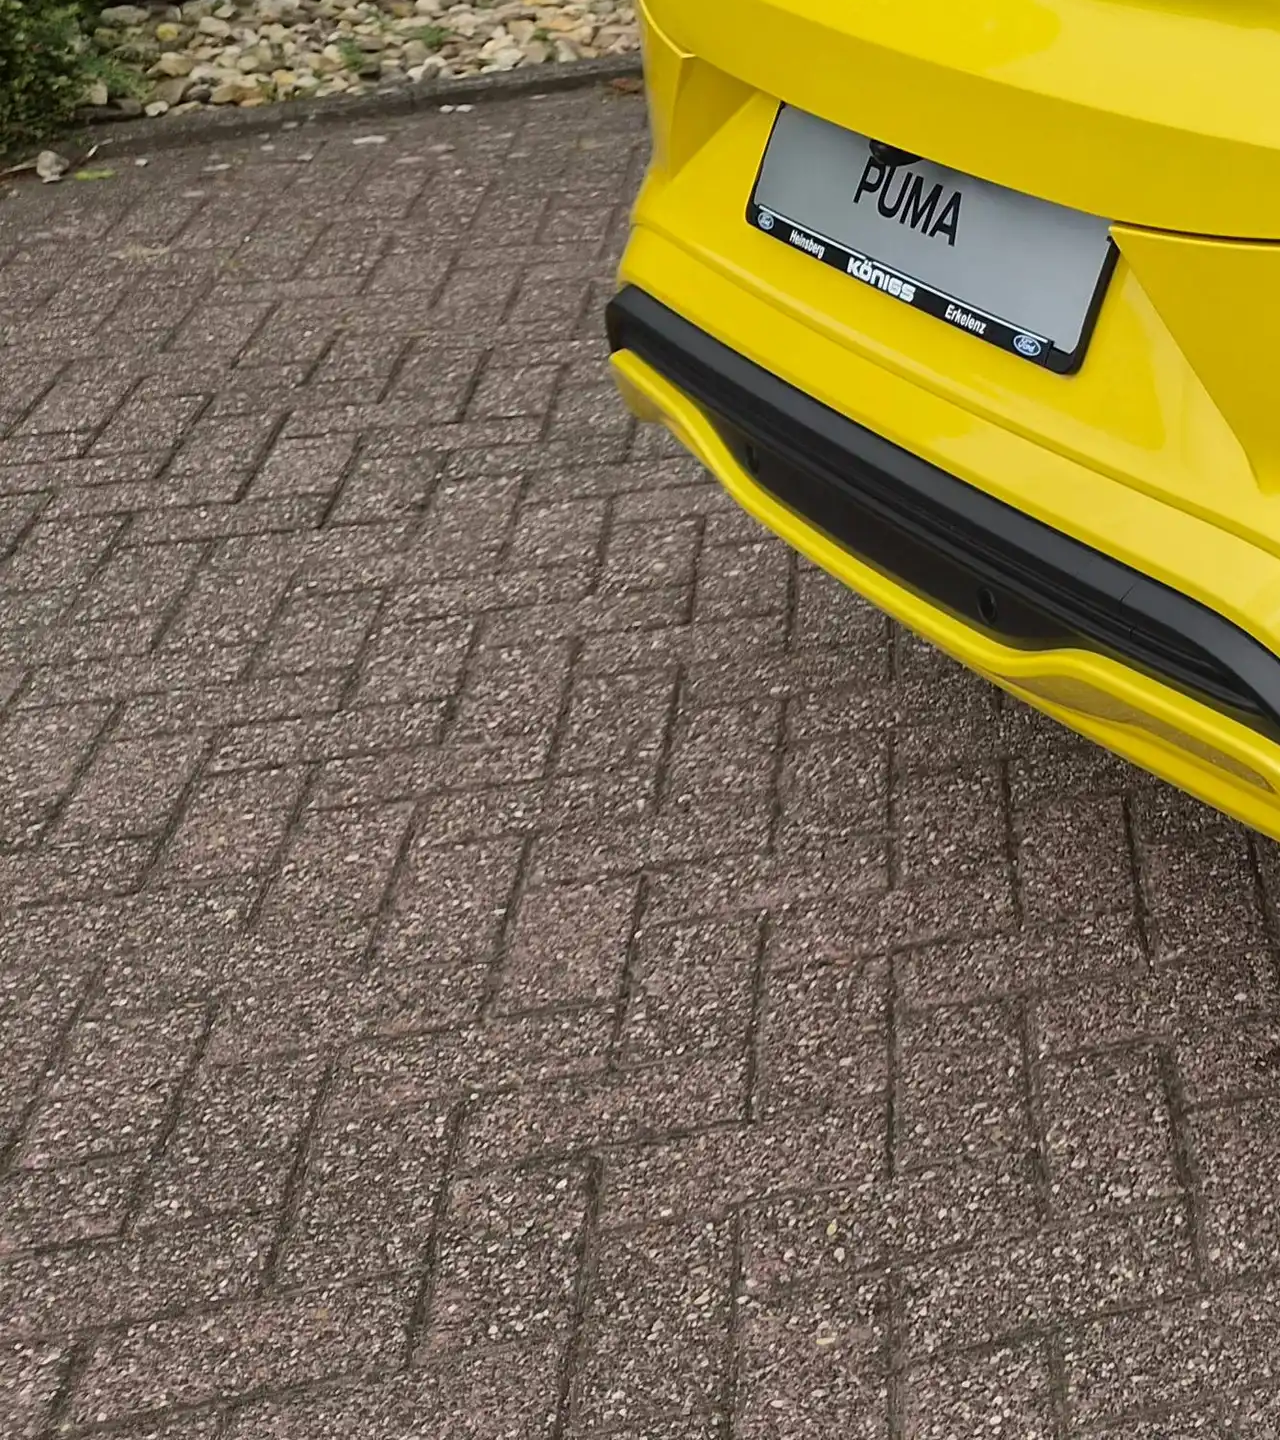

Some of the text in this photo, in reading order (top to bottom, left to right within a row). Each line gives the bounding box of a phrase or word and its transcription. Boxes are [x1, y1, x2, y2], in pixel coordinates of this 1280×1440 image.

[853, 155, 962, 247] PUMA
[789, 229, 826, 259] Heinsberg
[944, 303, 987, 335] Erkelenz
